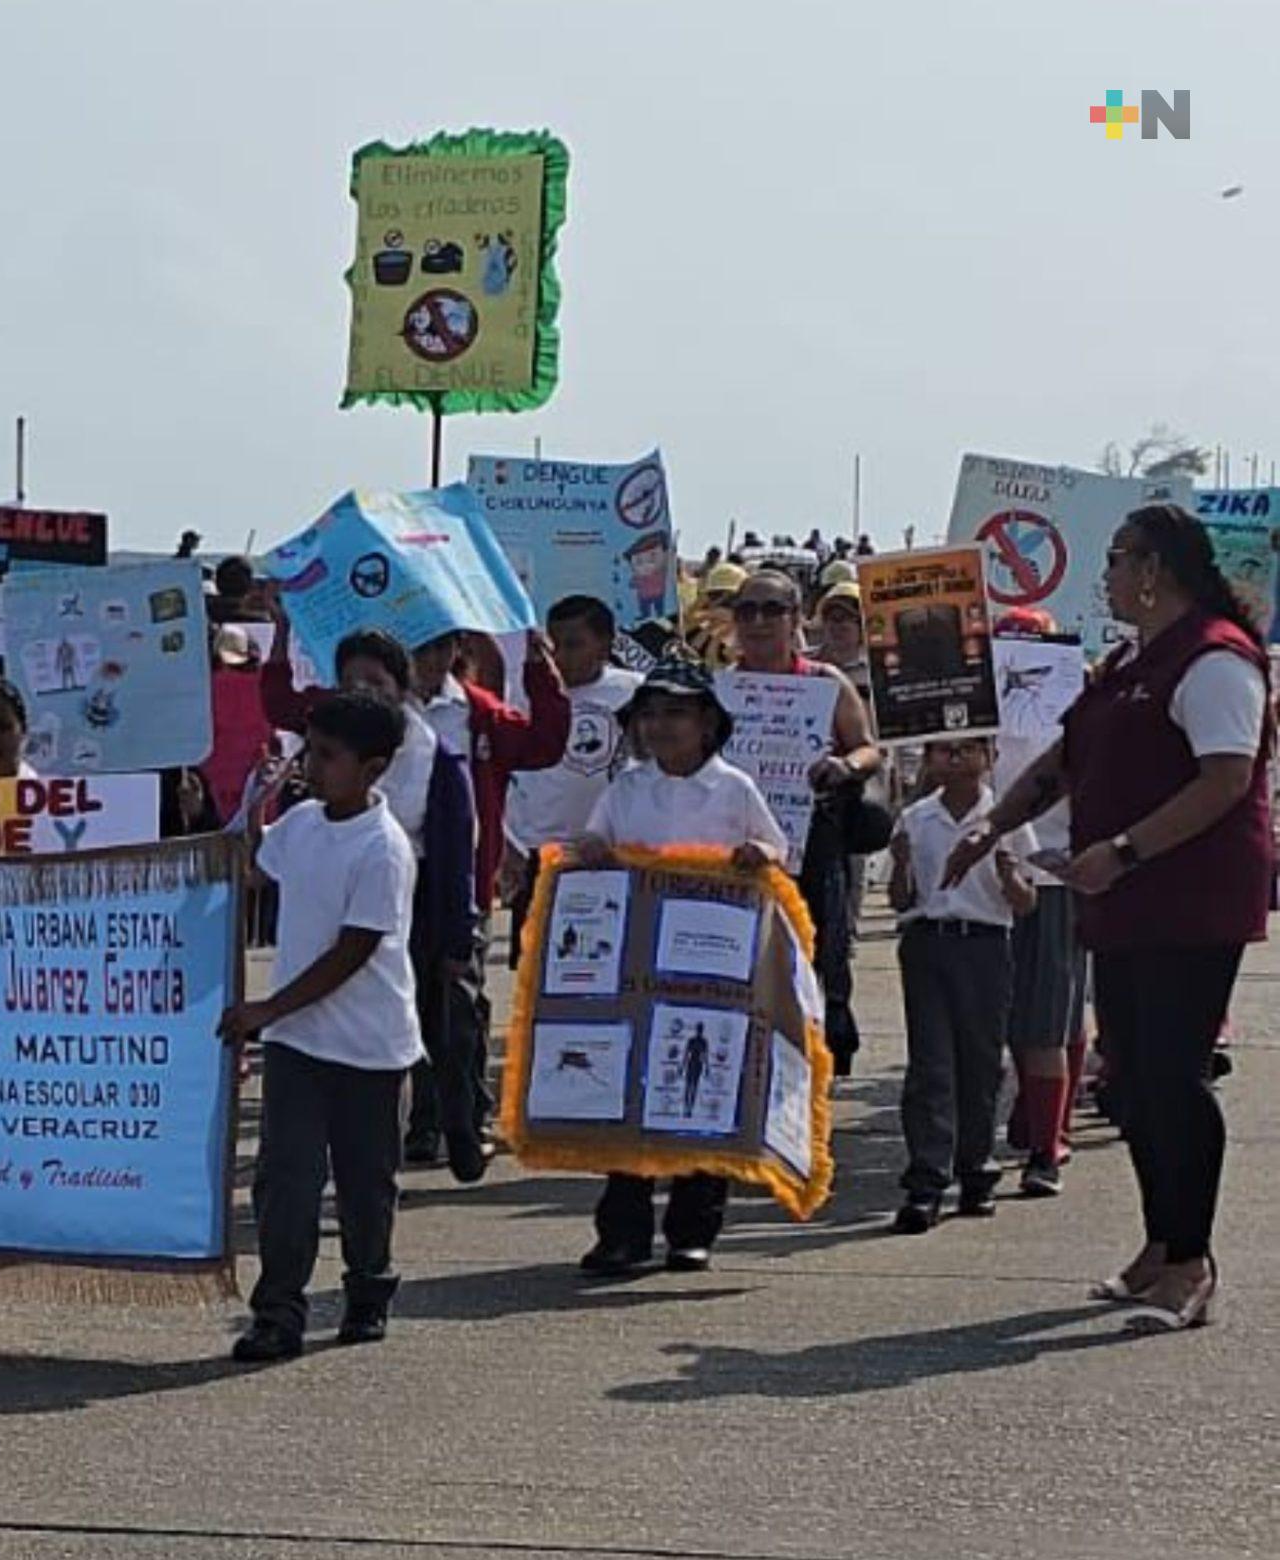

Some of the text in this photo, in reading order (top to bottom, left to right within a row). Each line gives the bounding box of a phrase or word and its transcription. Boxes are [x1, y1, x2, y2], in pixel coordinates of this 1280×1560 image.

[523, 464, 609, 484] DENGUE
[1197, 494, 1270, 516] ZIKA
[16, 779, 103, 816] DEL
[53, 819, 87, 850] Y
[24, 912, 98, 949] URBANA
[107, 912, 184, 949] ESTATAL
[4, 949, 90, 1015] Juárez
[16, 1034, 170, 1066] MATUTINO
[24, 1082, 119, 1108] ESCOLAR
[1, 1114, 160, 1140] VERACRUZ
[19, 1170, 34, 1190] y
